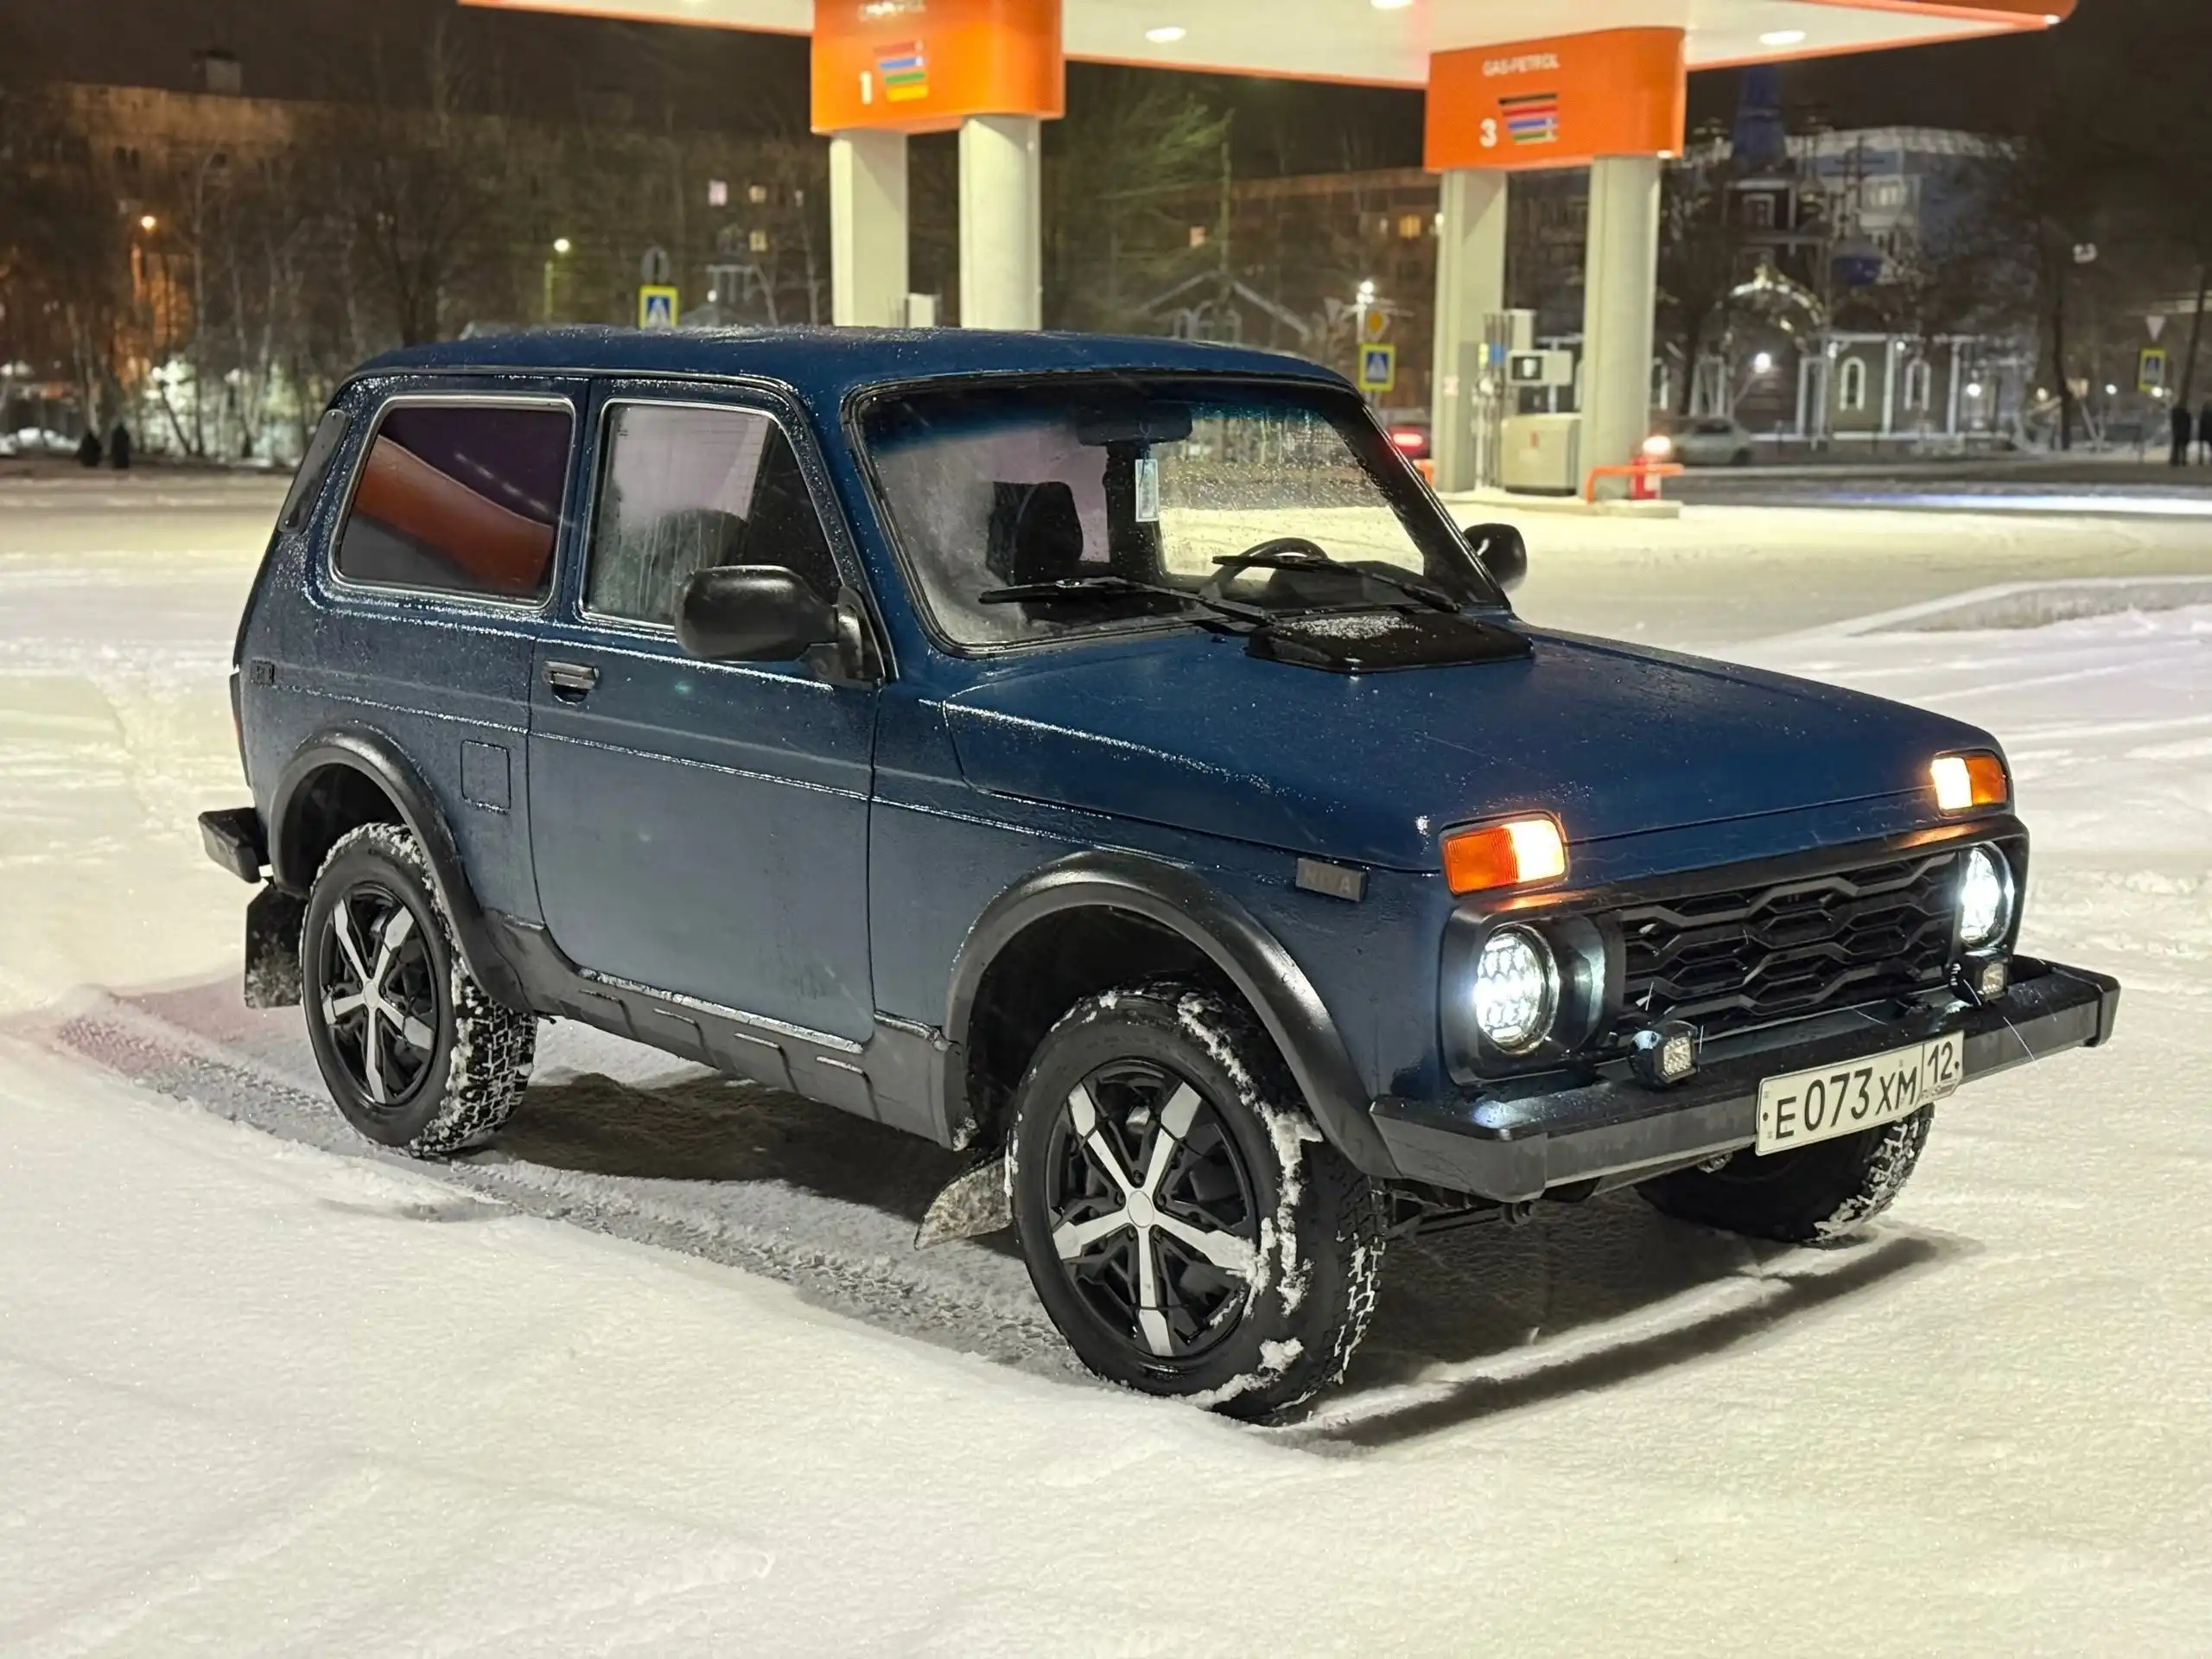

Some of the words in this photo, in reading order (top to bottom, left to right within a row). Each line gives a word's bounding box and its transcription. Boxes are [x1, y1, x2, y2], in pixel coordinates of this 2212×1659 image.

[860, 70, 873, 105] 1
[1479, 117, 1497, 149] 3
[1928, 1041, 1954, 1084] 12
